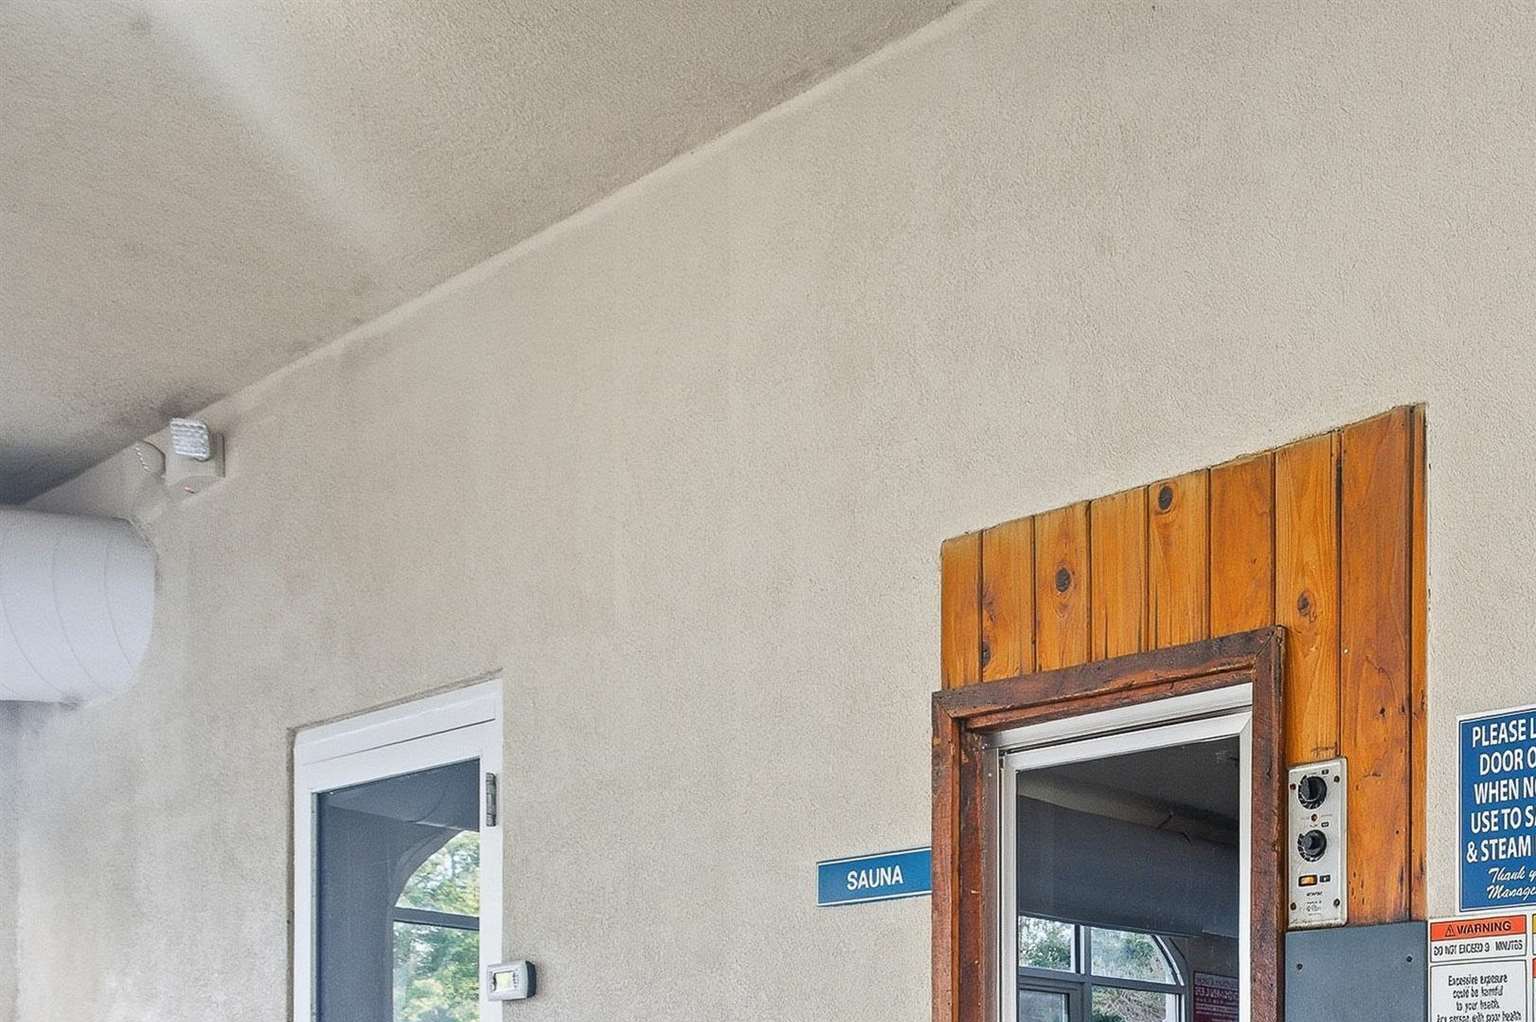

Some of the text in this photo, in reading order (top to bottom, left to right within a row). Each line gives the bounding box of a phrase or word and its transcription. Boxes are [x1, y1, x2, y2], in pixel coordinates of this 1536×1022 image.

[1472, 719, 1526, 747] PLEASE
[1480, 749, 1523, 776] DOOR
[1474, 778, 1519, 805] WHEN
[1471, 810, 1498, 833] USE
[1501, 807, 1522, 830] TO
[1466, 841, 1478, 863] &
[1481, 835, 1531, 862] STEAM
[847, 865, 904, 890] SAUNA
[1488, 865, 1526, 883] Thank
[1457, 921, 1512, 935] WARNING
